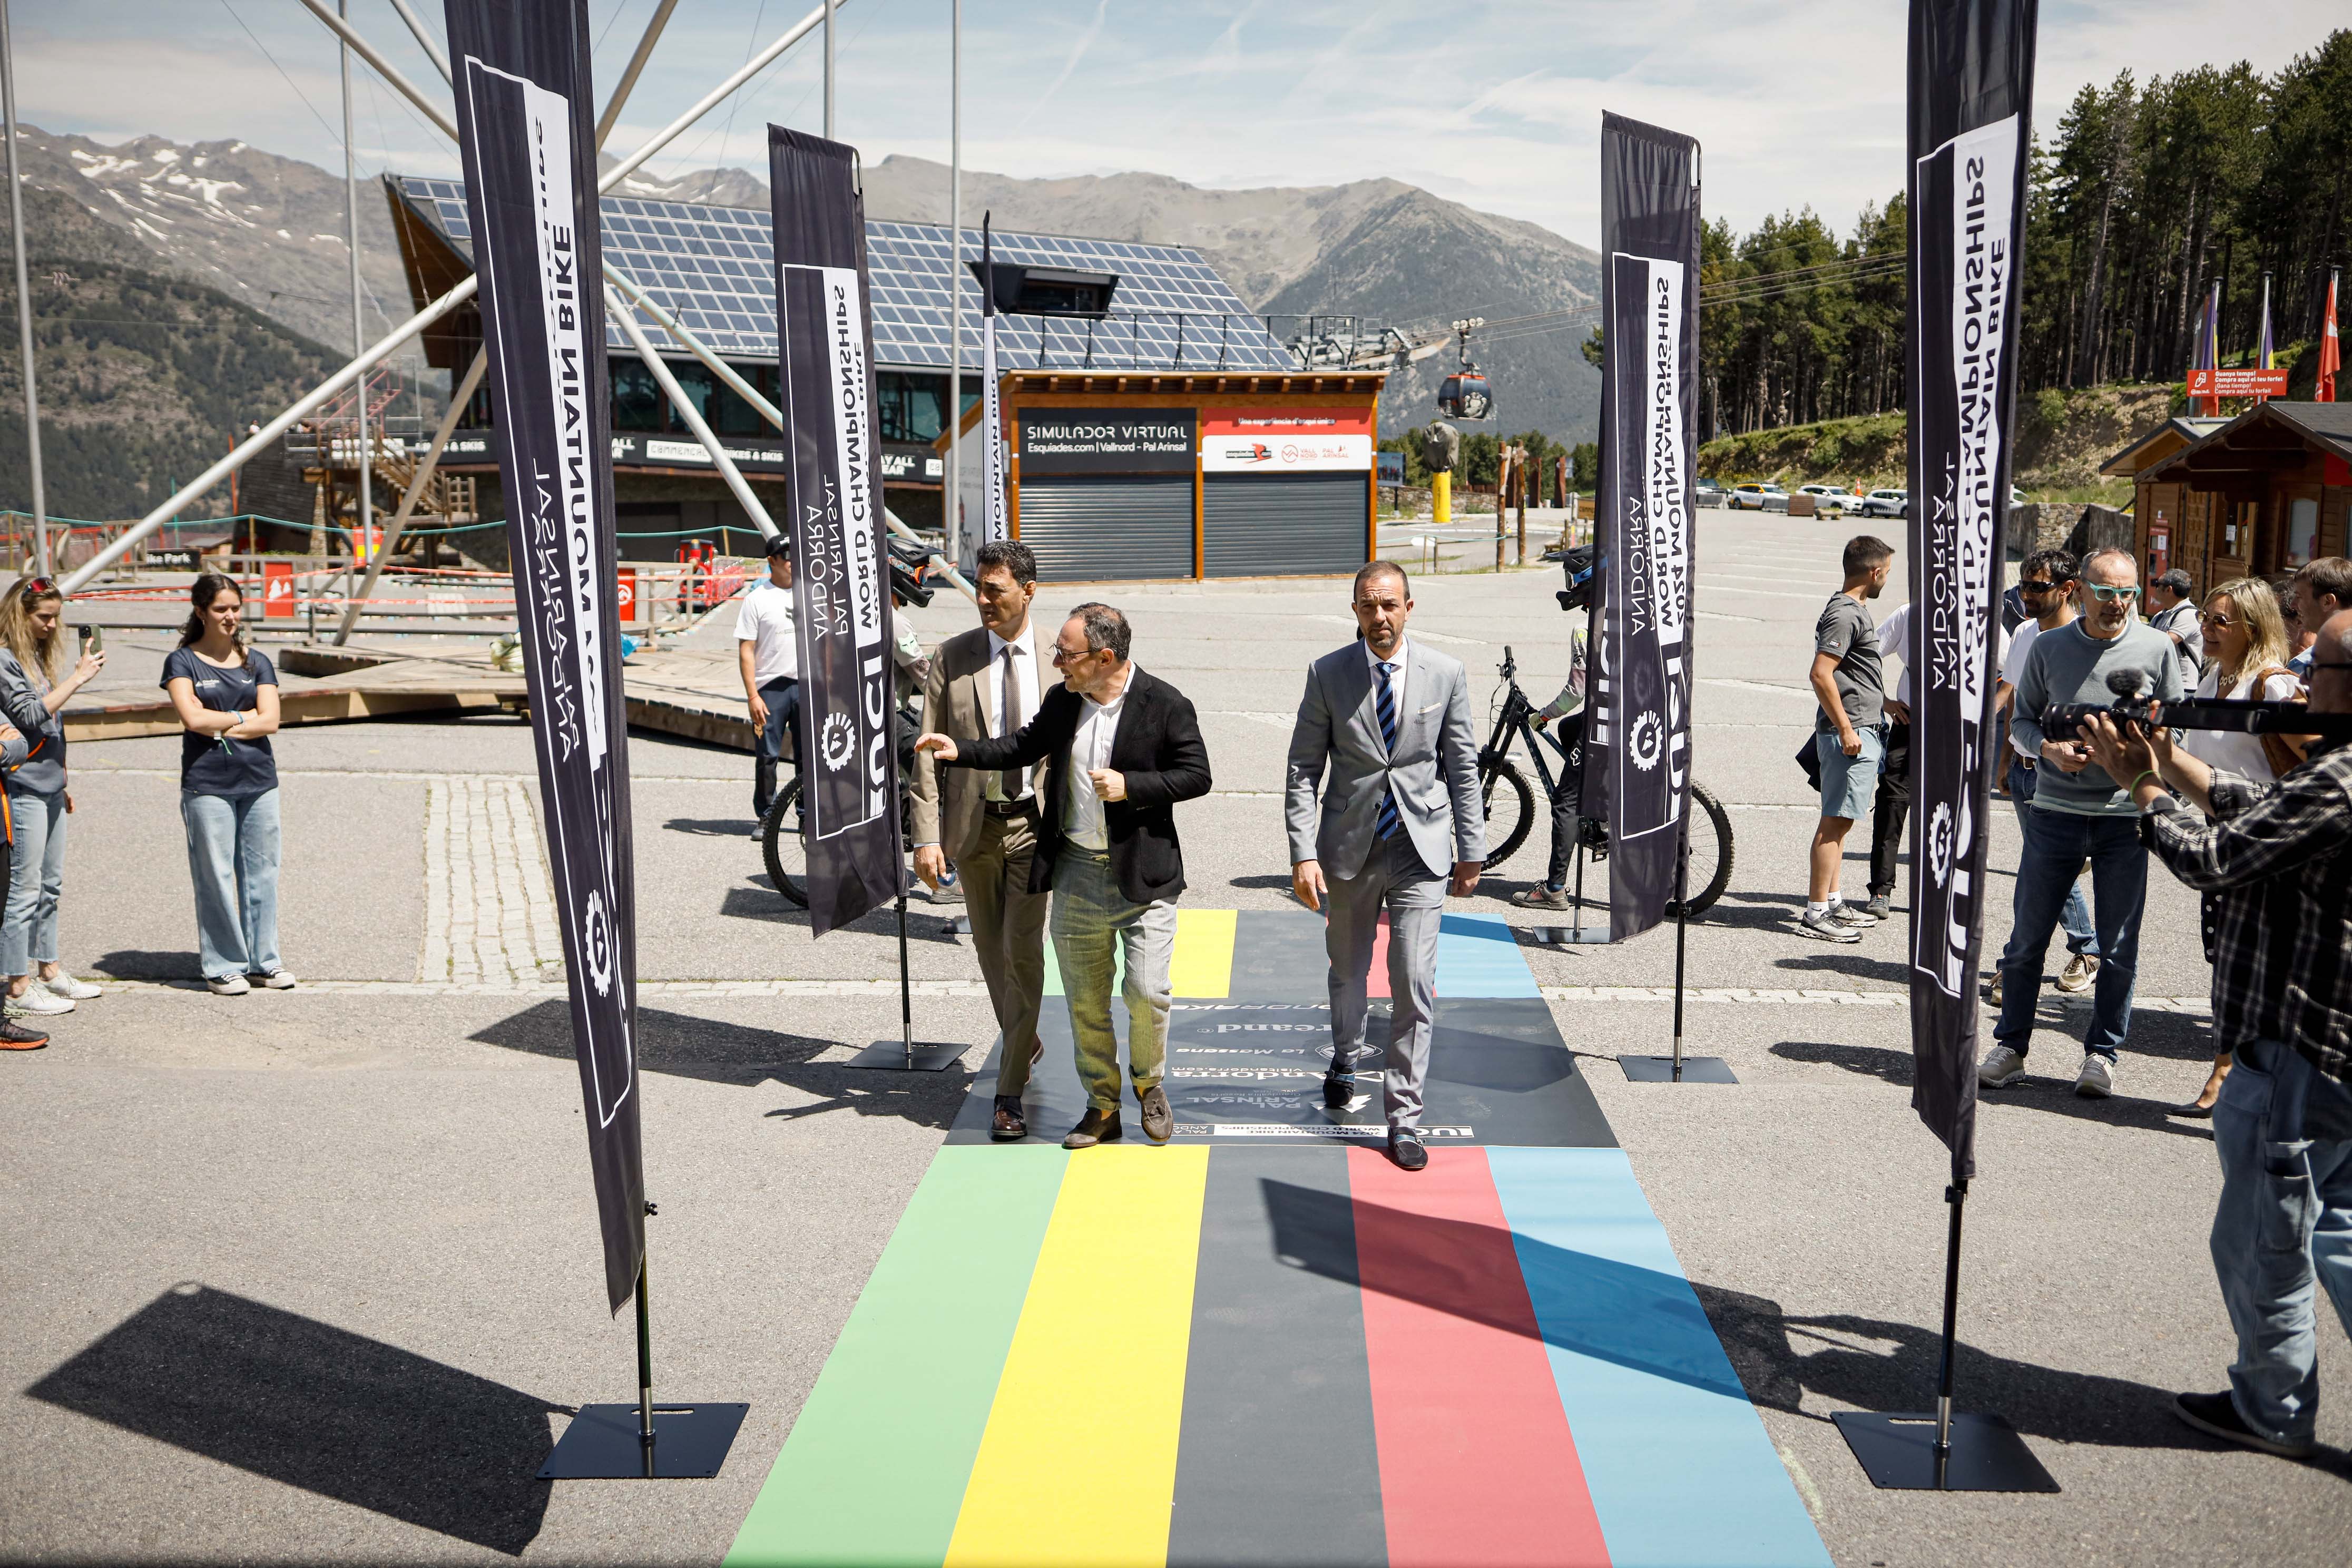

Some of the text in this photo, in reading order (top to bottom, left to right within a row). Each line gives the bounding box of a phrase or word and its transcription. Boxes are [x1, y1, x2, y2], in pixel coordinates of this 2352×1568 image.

[1027, 426, 1188, 439] SIMULADOR VIRTUAL
[459, 441, 486, 452] SKIS
[1027, 443, 1095, 454] Esquiades.com
[1100, 443, 1135, 452] Vallnord
[1143, 442, 1157, 452] Pal
[1157, 442, 1187, 452] Arinsal
[752, 451, 760, 461] &
[761, 452, 784, 462] SKIS
[894, 456, 916, 467] ALL
[993, 425, 1002, 540] MOUNTAIN
[146, 552, 191, 565] ike Park
[1216, 1023, 1332, 1033] reand
[1171, 1070, 1327, 1081] Andorra
